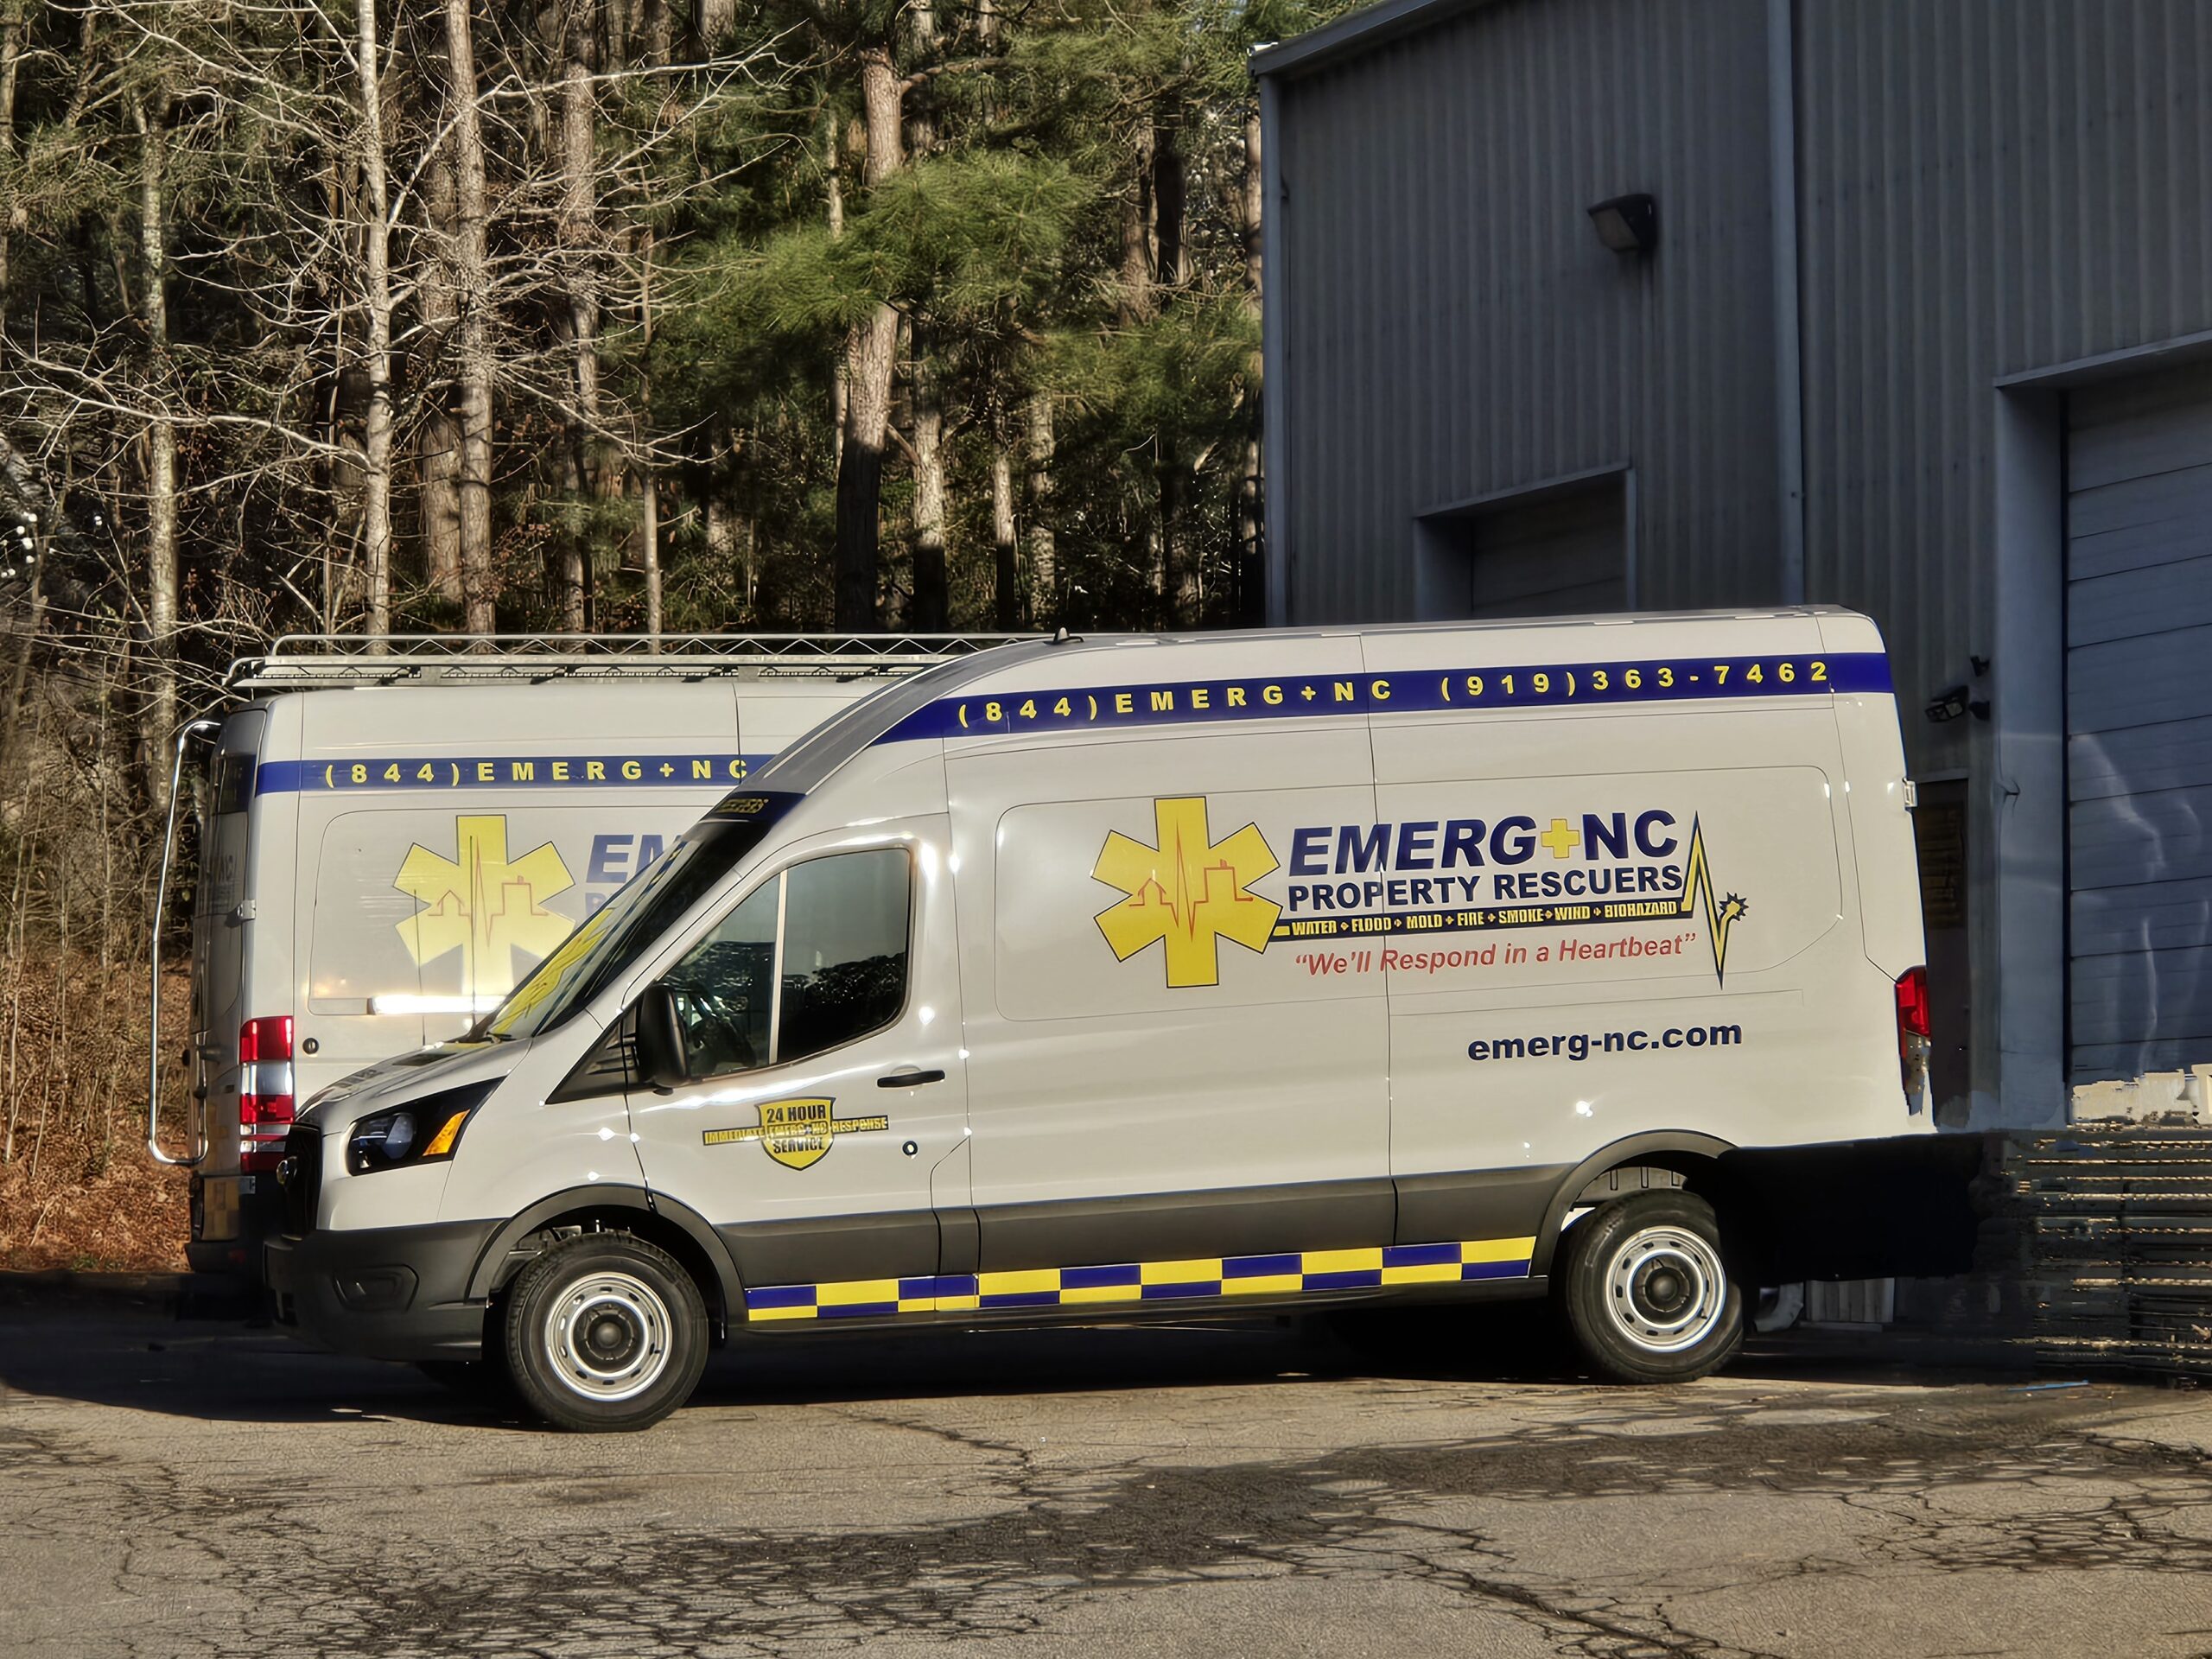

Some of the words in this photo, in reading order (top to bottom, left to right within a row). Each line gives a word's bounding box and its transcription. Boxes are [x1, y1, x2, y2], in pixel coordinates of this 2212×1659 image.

[1440, 660, 1827, 702] (919)363-7462
[1288, 875, 1481, 912] PROPERTY
[1495, 864, 1684, 900] RESCUERS
[1292, 919, 1337, 936] WATER
[1351, 917, 1392, 932] FLOOD
[1406, 914, 1442, 929] MOLD
[1457, 911, 1485, 926] FIRE
[1498, 908, 1543, 924] SMOKE
[1554, 906, 1591, 921] WIND
[1605, 901, 1678, 918] BIOHAZARD
[1380, 944, 1497, 975] Respond
[1504, 942, 1528, 964] in
[1535, 946, 1550, 963] a
[1559, 932, 1697, 962] Heartbeat”
[1467, 1023, 1743, 1061] emerg-nc.com
[766, 1107, 784, 1123] 24
[787, 1104, 826, 1122] HOUR
[832, 1116, 888, 1133] RESPONSE
[772, 1137, 824, 1154] SERVICE
